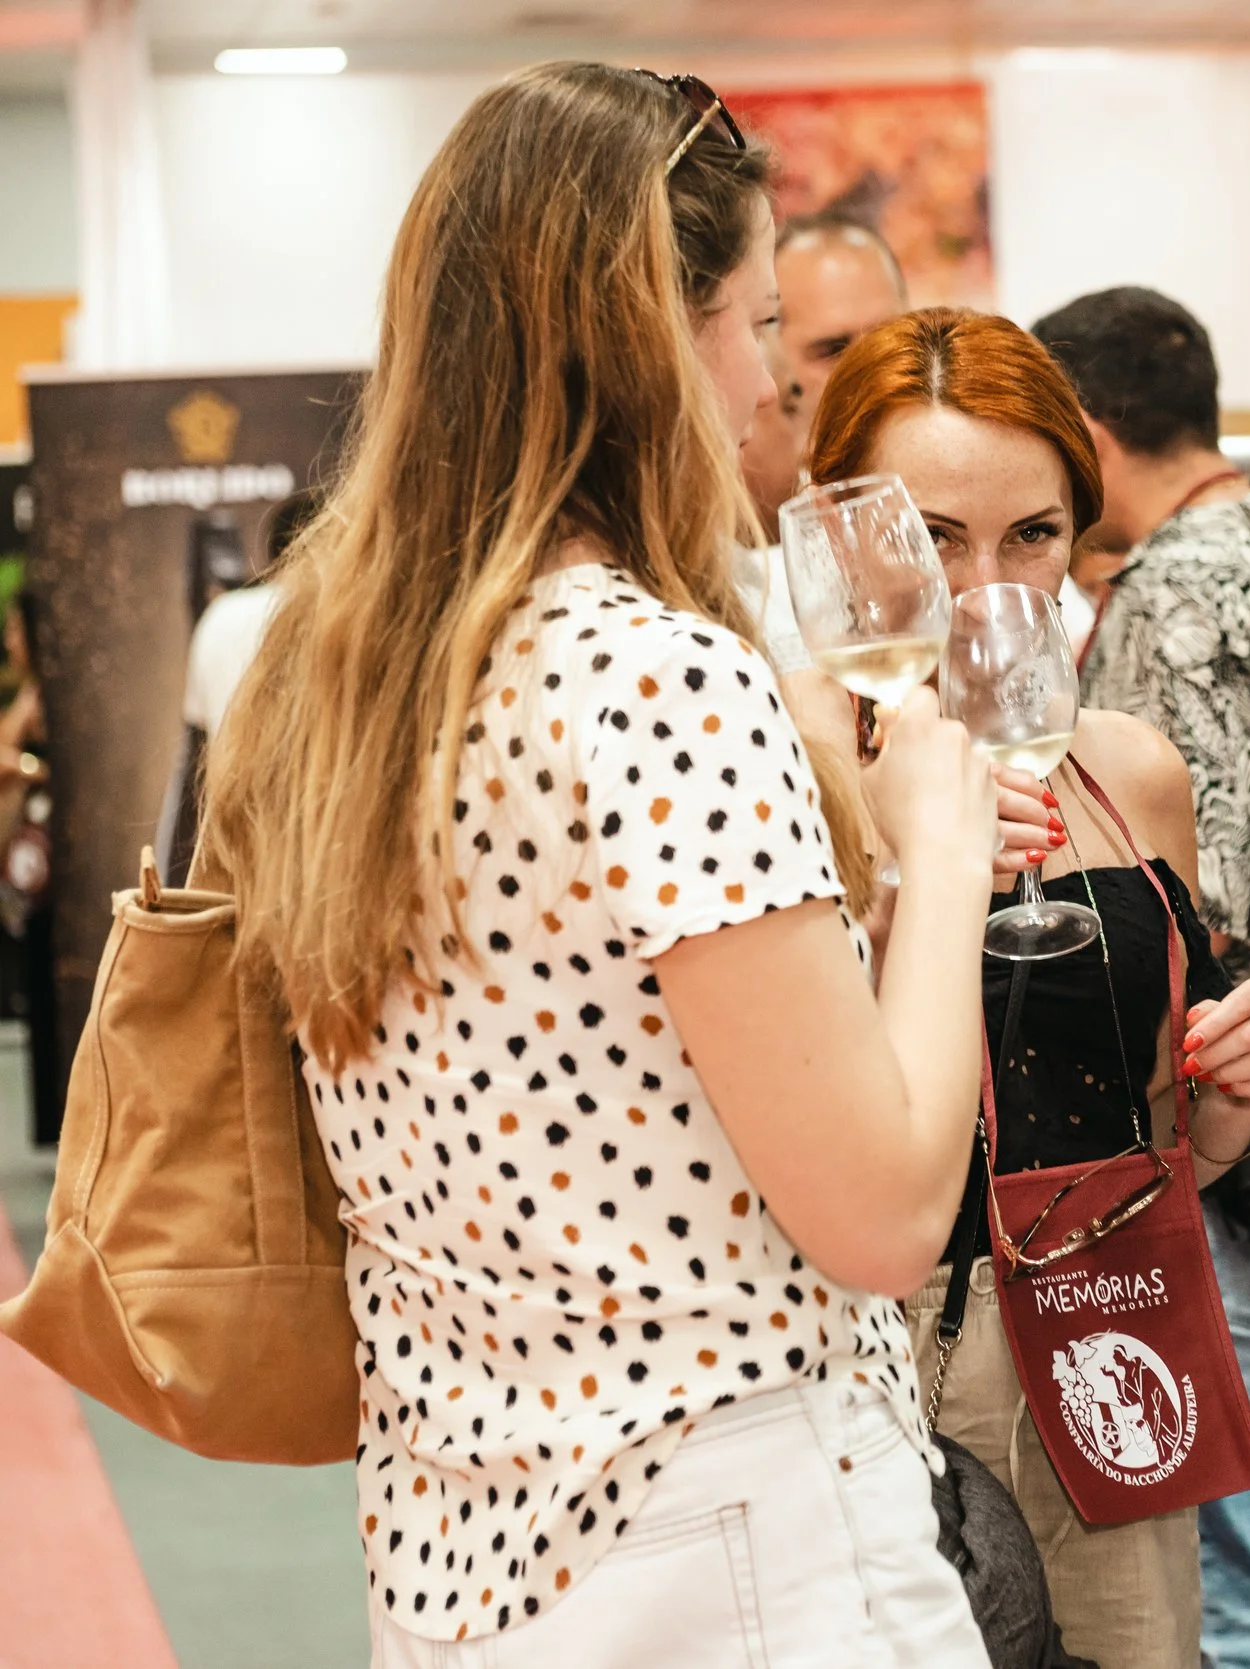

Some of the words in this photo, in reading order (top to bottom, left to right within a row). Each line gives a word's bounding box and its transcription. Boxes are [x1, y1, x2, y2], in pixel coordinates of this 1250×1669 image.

[1031, 1269, 1089, 1286] RESTAURANTE
[1034, 1267, 1166, 1316] MEMÓRIAS
[1101, 1294, 1170, 1315] MEMORIES
[1059, 1400, 1105, 1474] CONFRARIA
[1105, 1465, 1122, 1482] DO
[1124, 1462, 1176, 1486] BACCHUS
[1173, 1449, 1188, 1468] DE
[1181, 1373, 1198, 1452] ALBUFEIRA
